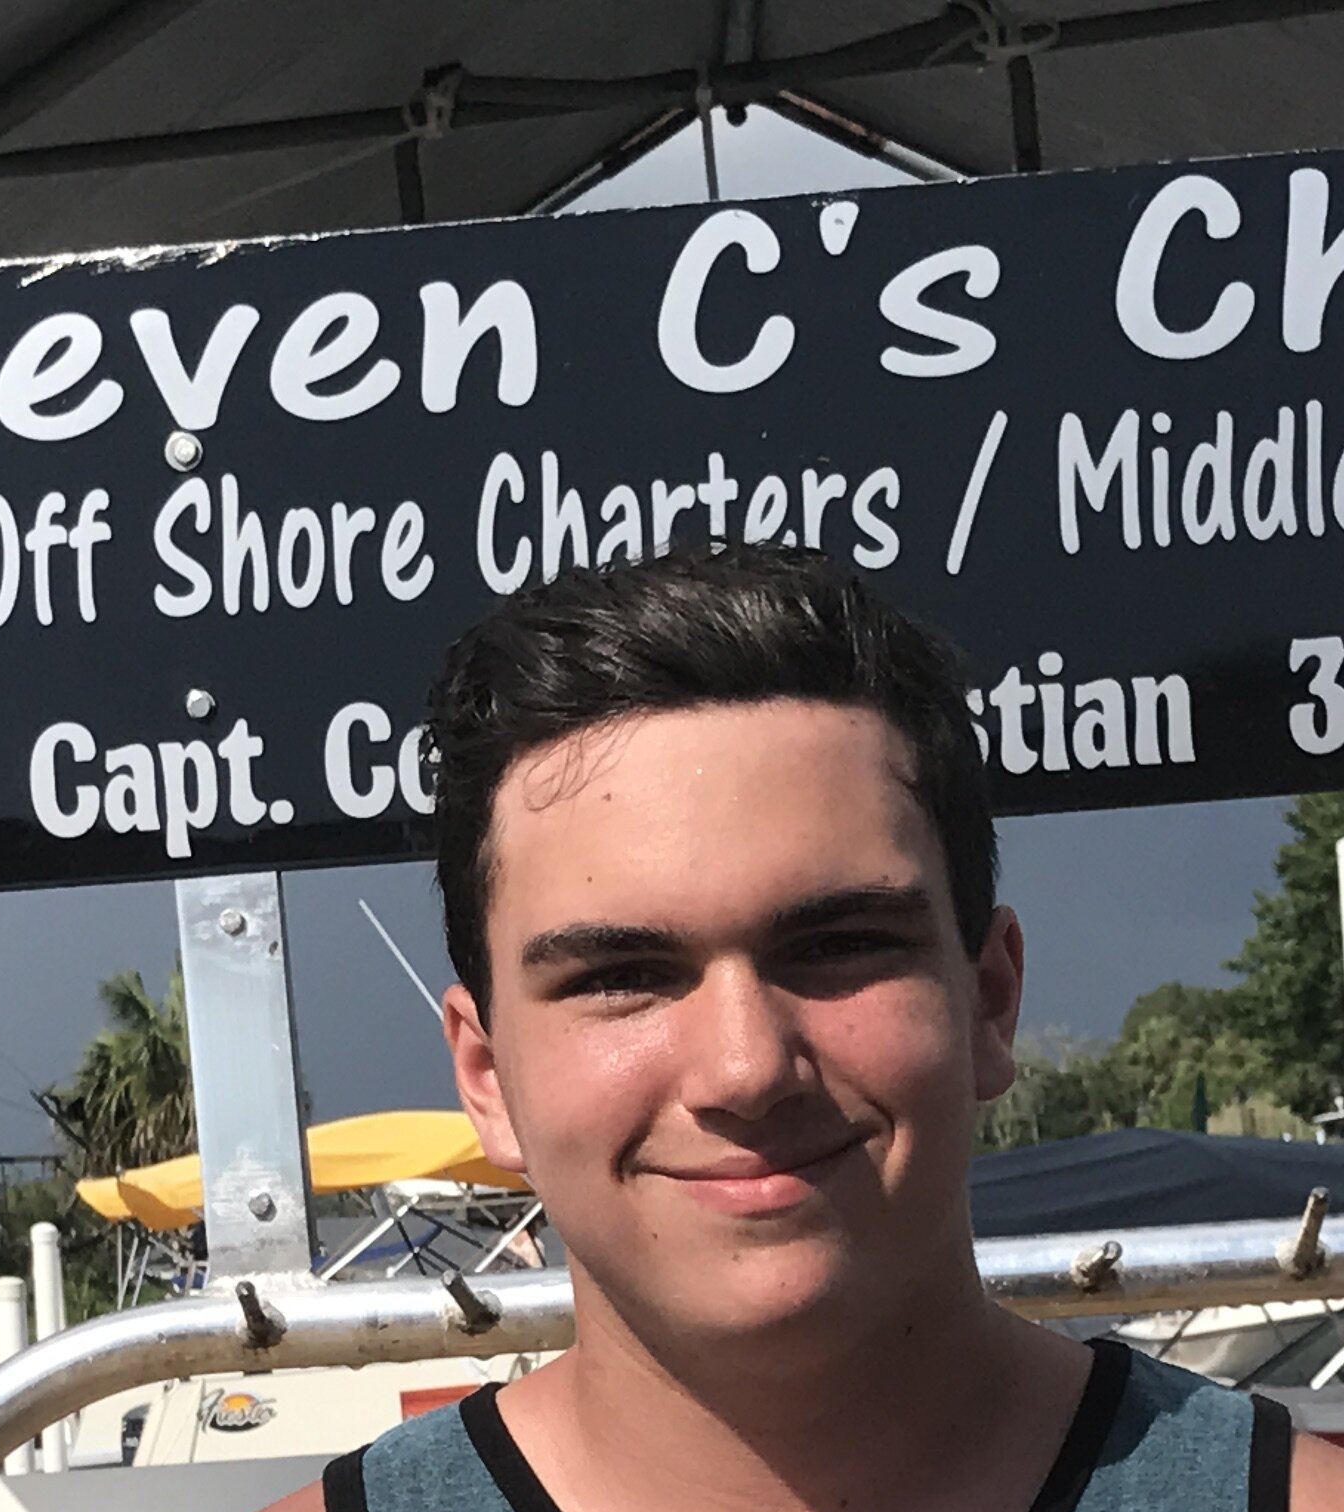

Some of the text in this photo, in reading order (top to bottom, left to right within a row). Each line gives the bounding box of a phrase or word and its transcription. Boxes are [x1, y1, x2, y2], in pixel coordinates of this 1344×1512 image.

[658, 200, 1000, 393] C's
[154, 473, 434, 617] Shore
[477, 450, 900, 595] Charters
[946, 410, 1008, 575] /
[29, 718, 294, 859] Capt.
[965, 651, 1196, 774] stian
